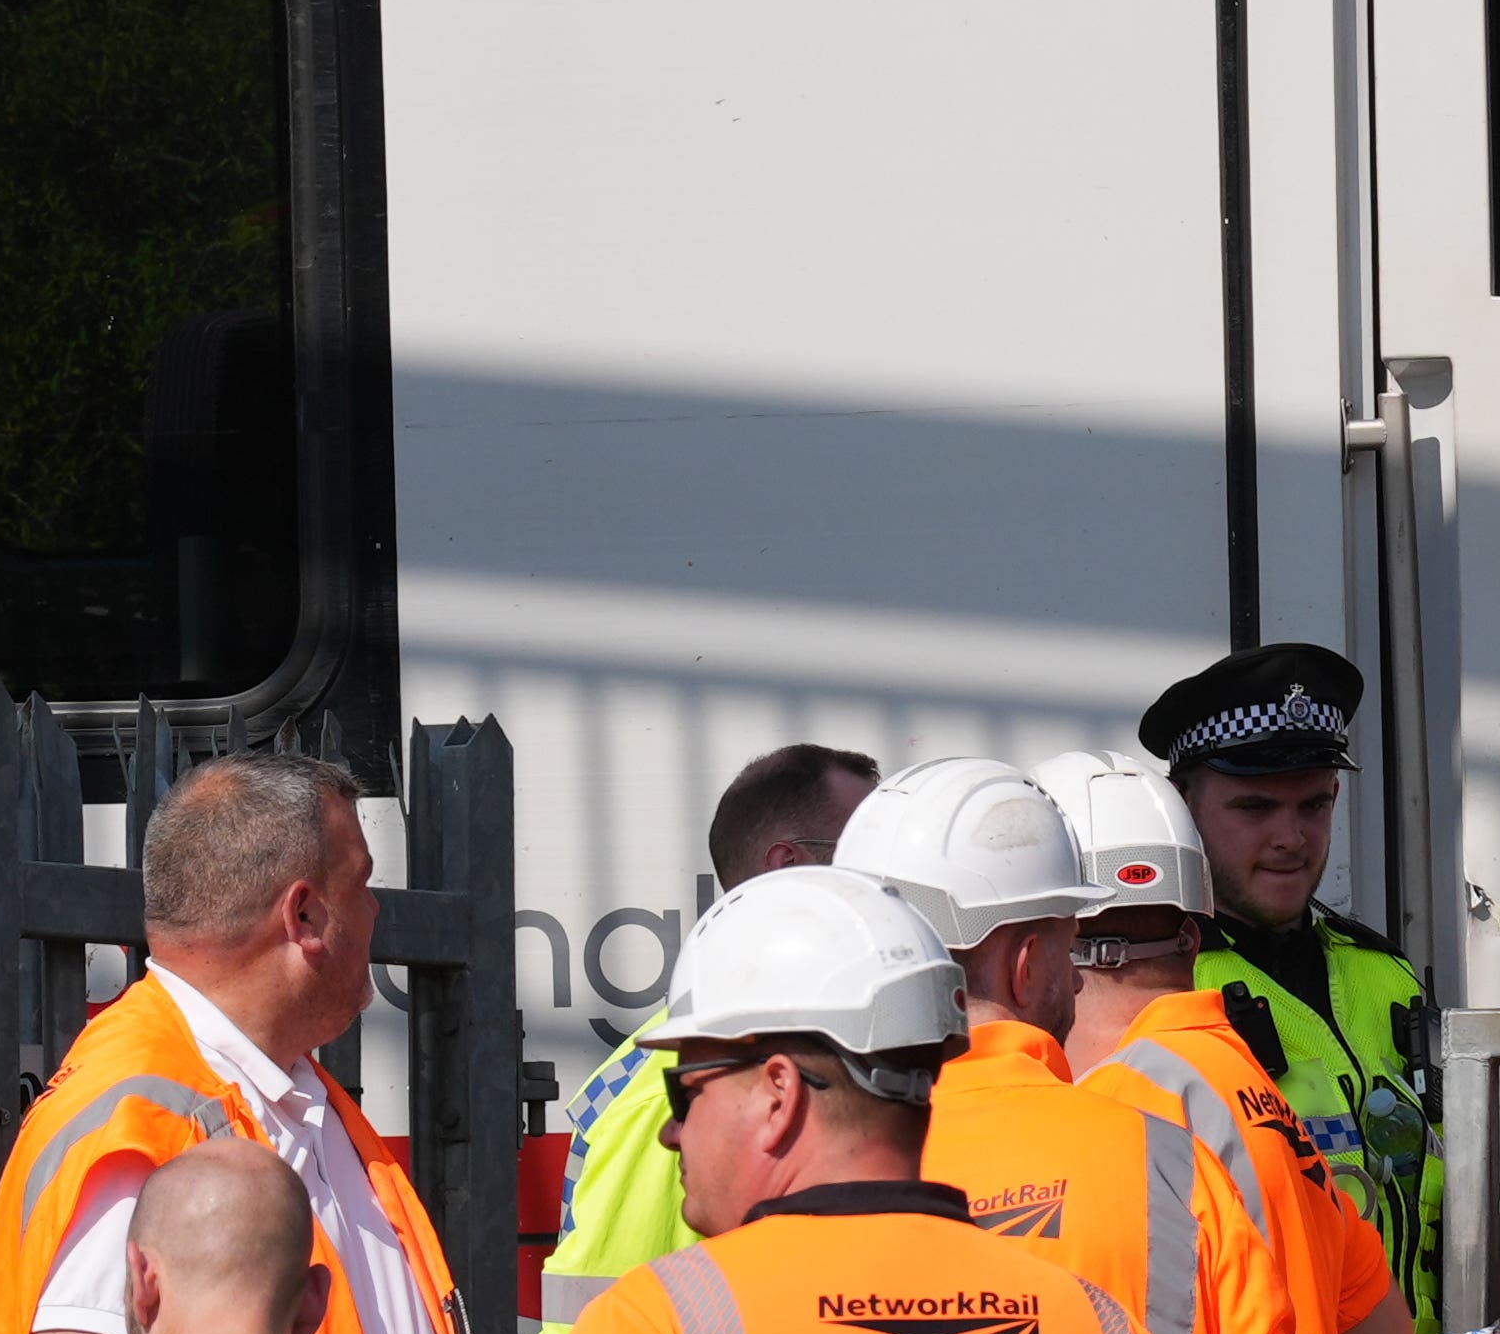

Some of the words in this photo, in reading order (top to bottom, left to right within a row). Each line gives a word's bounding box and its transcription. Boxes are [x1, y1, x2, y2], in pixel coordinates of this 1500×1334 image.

[1124, 869, 1151, 879] JSP
[968, 1178, 1067, 1213] orkRail
[819, 1291, 1039, 1318] NetworkRail
